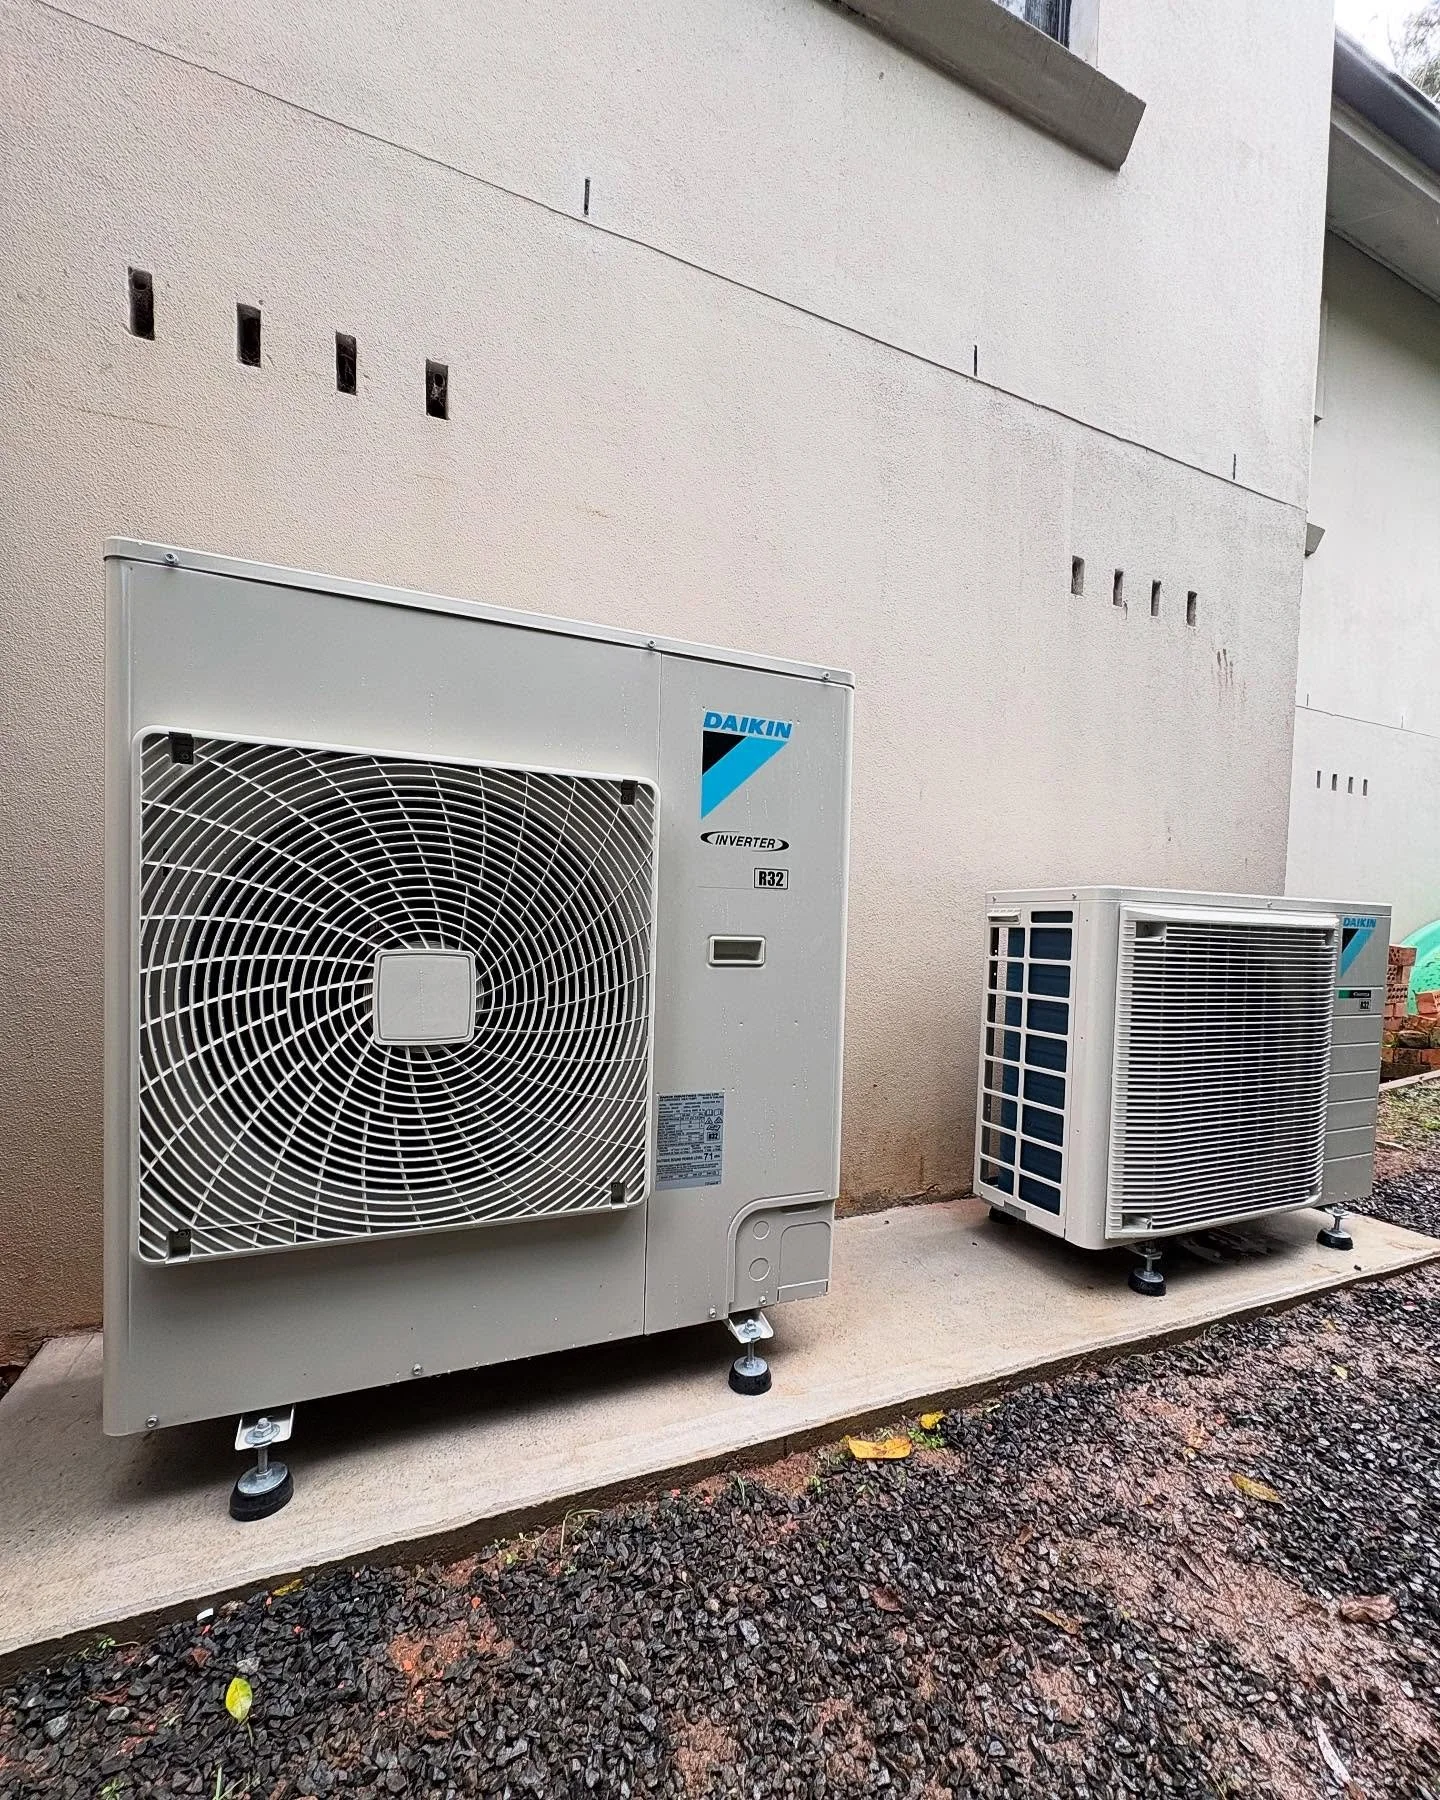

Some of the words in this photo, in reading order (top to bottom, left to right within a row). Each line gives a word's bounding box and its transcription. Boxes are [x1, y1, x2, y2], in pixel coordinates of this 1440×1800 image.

[703, 711, 793, 739] DAIKIN
[715, 834, 776, 850] INVERTER
[758, 870, 784, 887] R32
[1343, 917, 1376, 929] DAIKIN
[704, 1153, 713, 1161] 71
